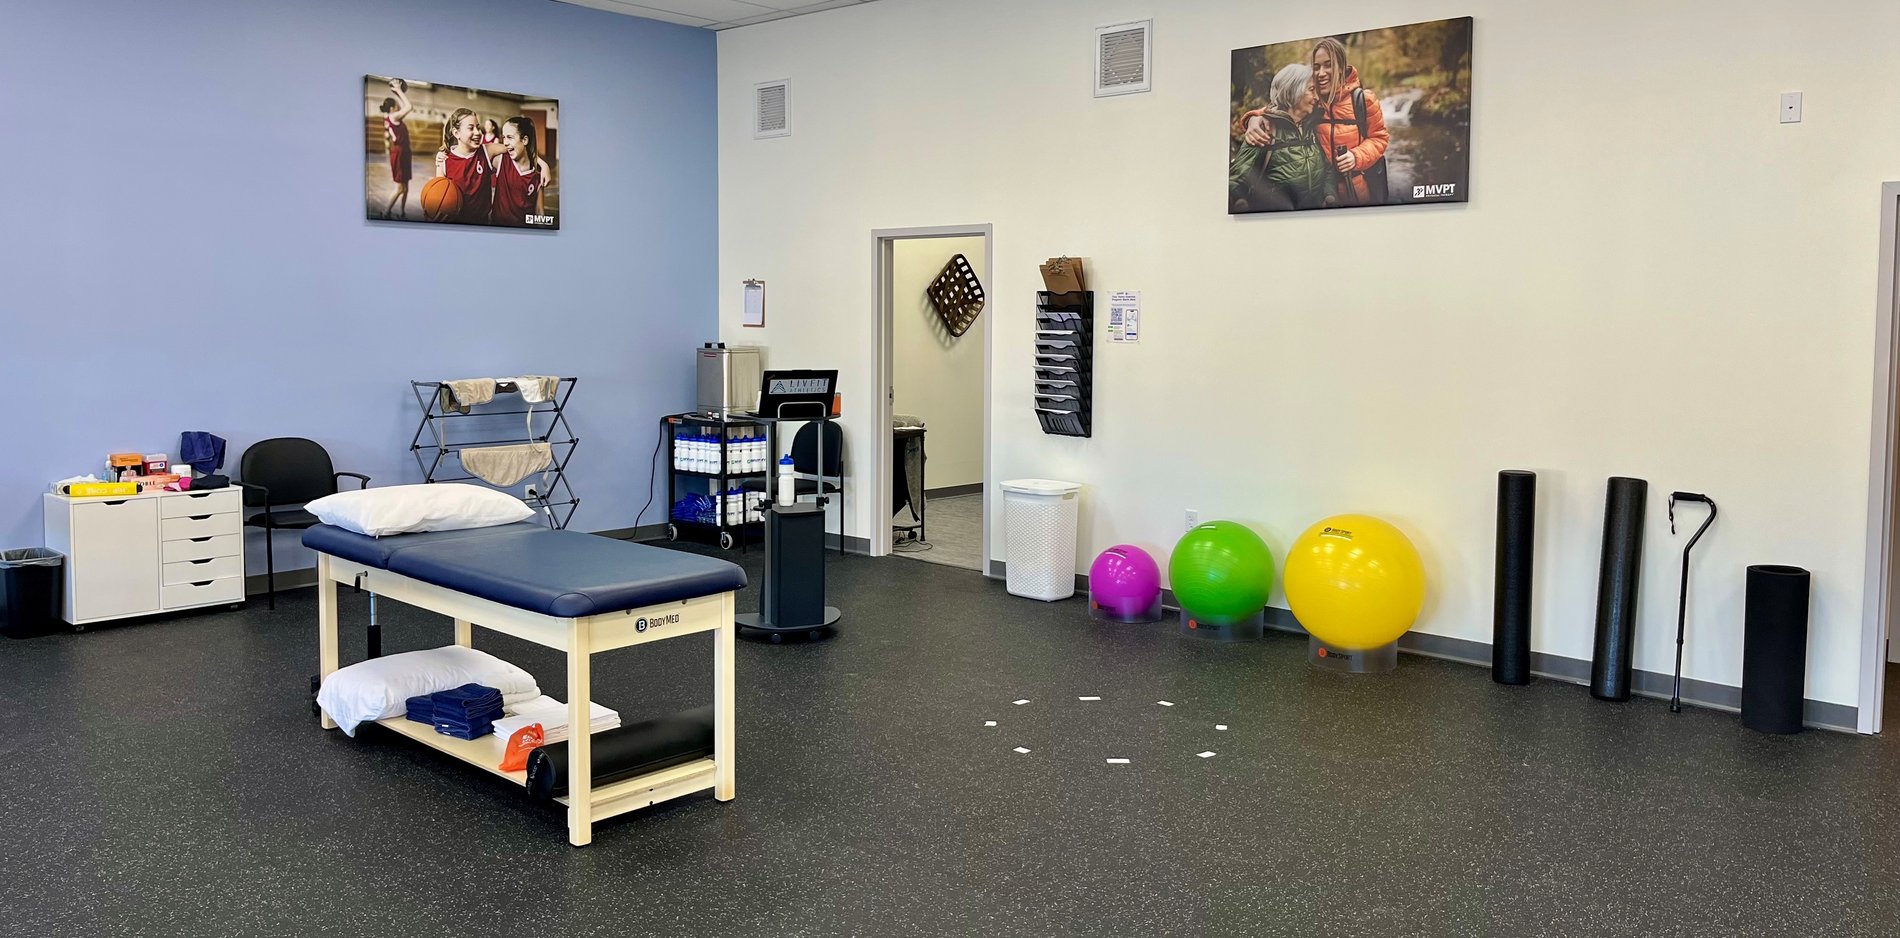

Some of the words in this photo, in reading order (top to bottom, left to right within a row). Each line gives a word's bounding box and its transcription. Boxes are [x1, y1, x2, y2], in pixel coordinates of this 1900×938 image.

[476, 161, 484, 174] 6
[527, 184, 535, 196] 9
[1425, 183, 1456, 195] MVPT
[534, 215, 554, 223] MVPT
[789, 379, 826, 388] LIVFIT
